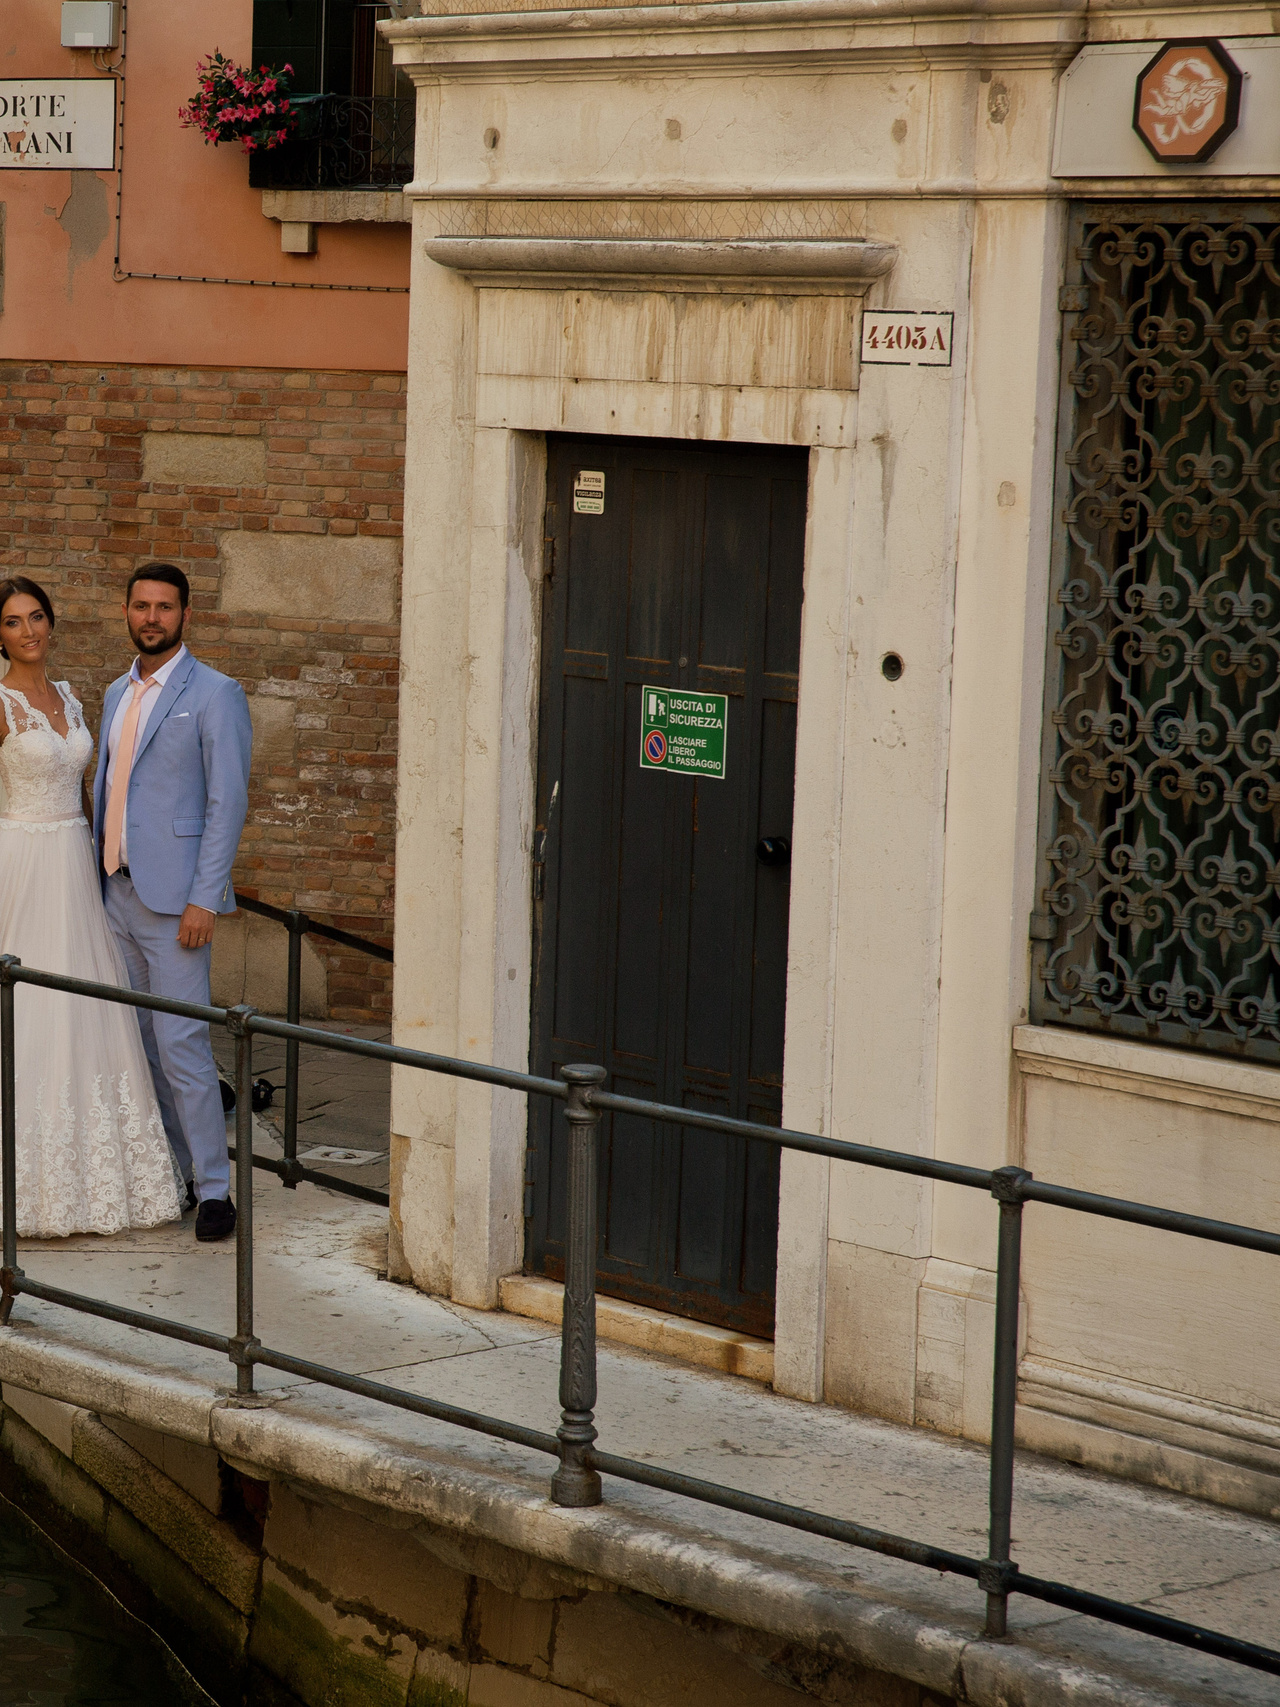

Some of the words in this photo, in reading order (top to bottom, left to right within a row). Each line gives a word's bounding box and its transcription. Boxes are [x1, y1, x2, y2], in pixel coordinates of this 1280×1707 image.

[670, 699, 703, 712] USCITA
[706, 703, 716, 713] DI
[670, 714, 722, 729] SICUREZZA
[669, 736, 707, 747] LASCIARE
[669, 746, 695, 756] LIBERO
[668, 755, 674, 763] IL
[676, 757, 721, 770] PASSAGGIO
